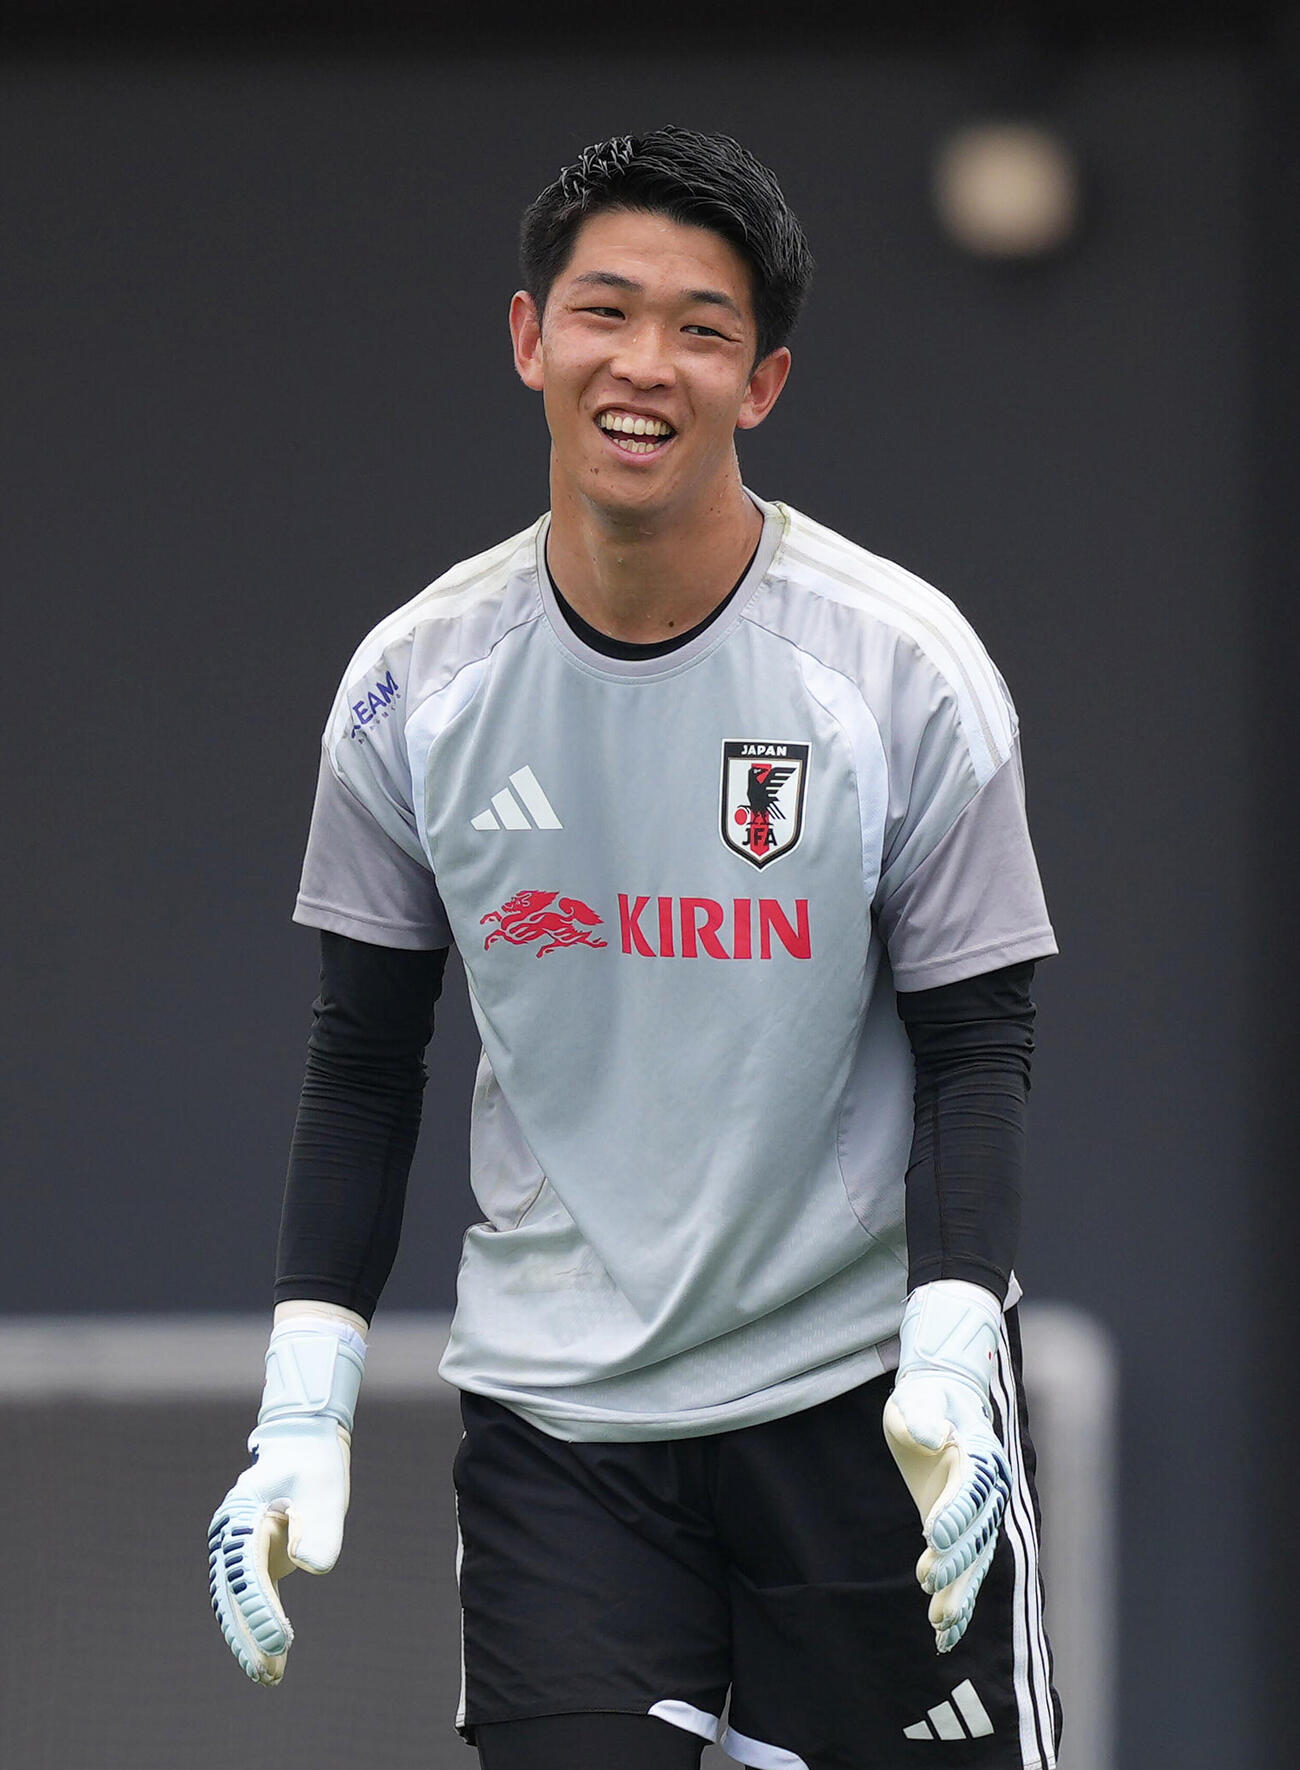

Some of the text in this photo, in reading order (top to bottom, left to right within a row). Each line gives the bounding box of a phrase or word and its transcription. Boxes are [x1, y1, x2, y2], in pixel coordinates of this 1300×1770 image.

[741, 745, 787, 756] JAPAN
[742, 827, 778, 846] JFA
[617, 893, 812, 960] KIRIN
